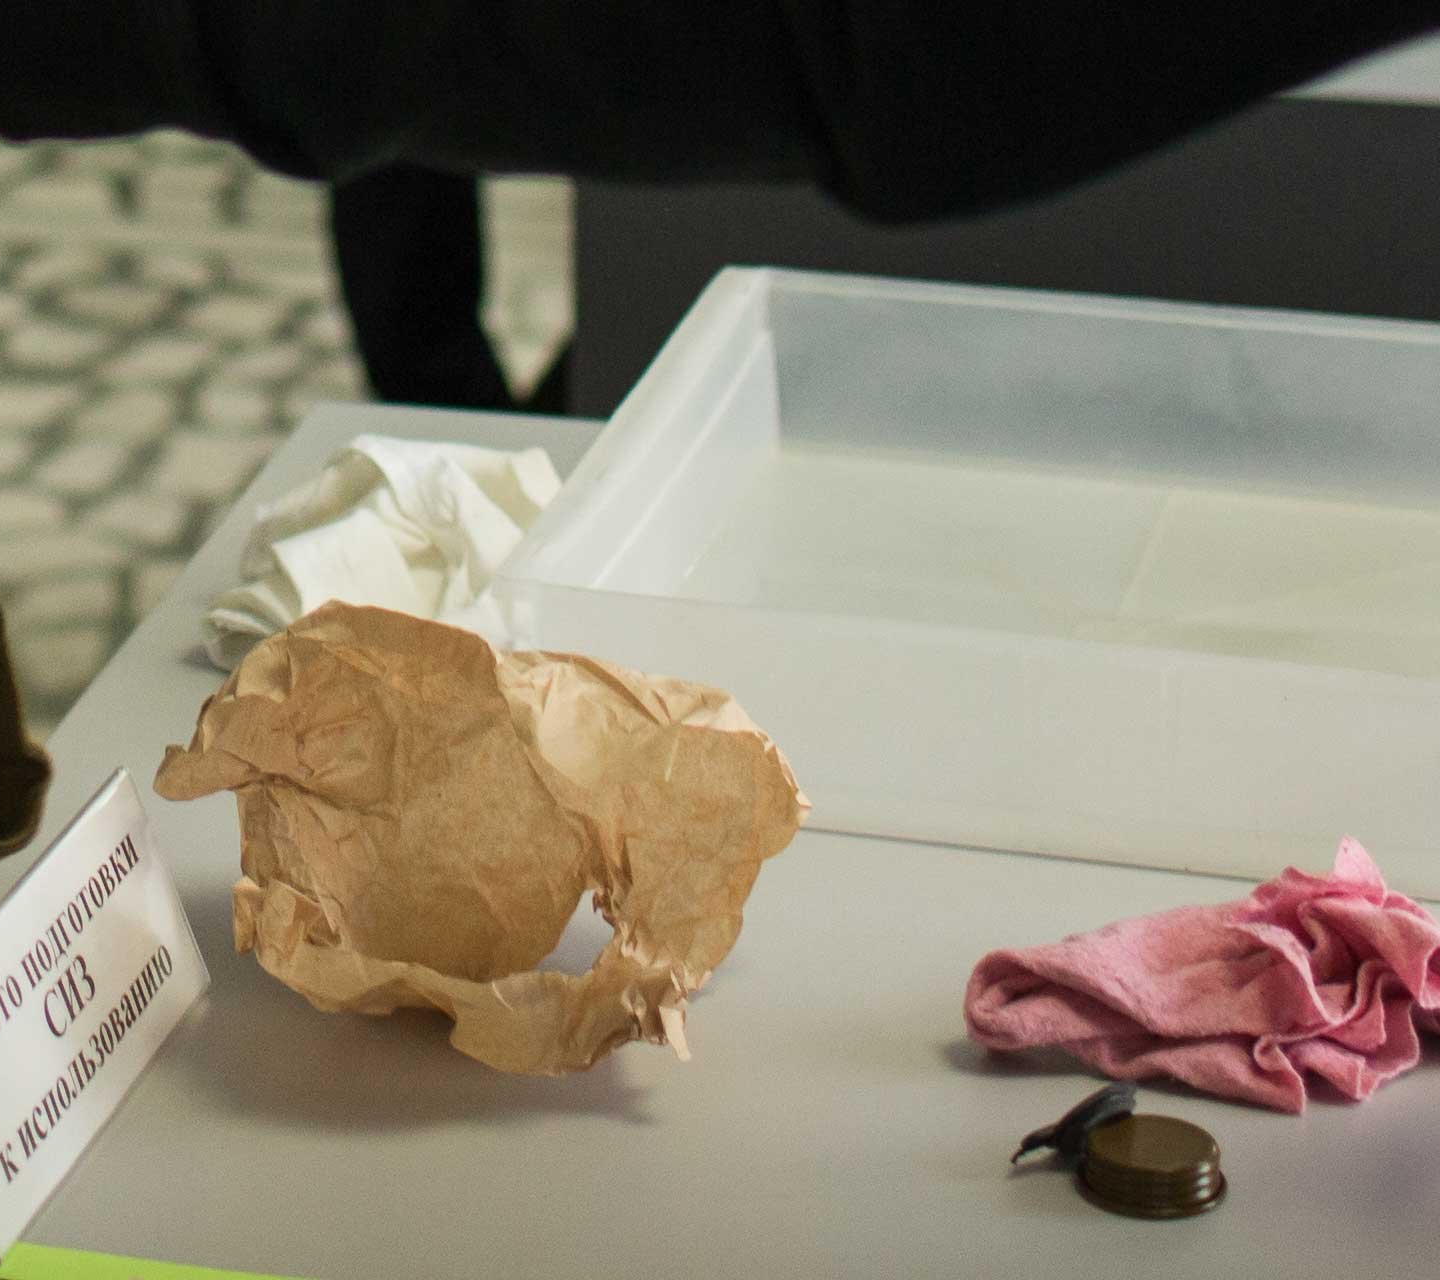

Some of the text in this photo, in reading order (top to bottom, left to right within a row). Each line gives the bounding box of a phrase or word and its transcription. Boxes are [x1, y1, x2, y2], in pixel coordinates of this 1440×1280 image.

[21, 834, 141, 991] подготовки
[17, 944, 174, 1160] использованию
[43, 954, 97, 1039] СИЗ
